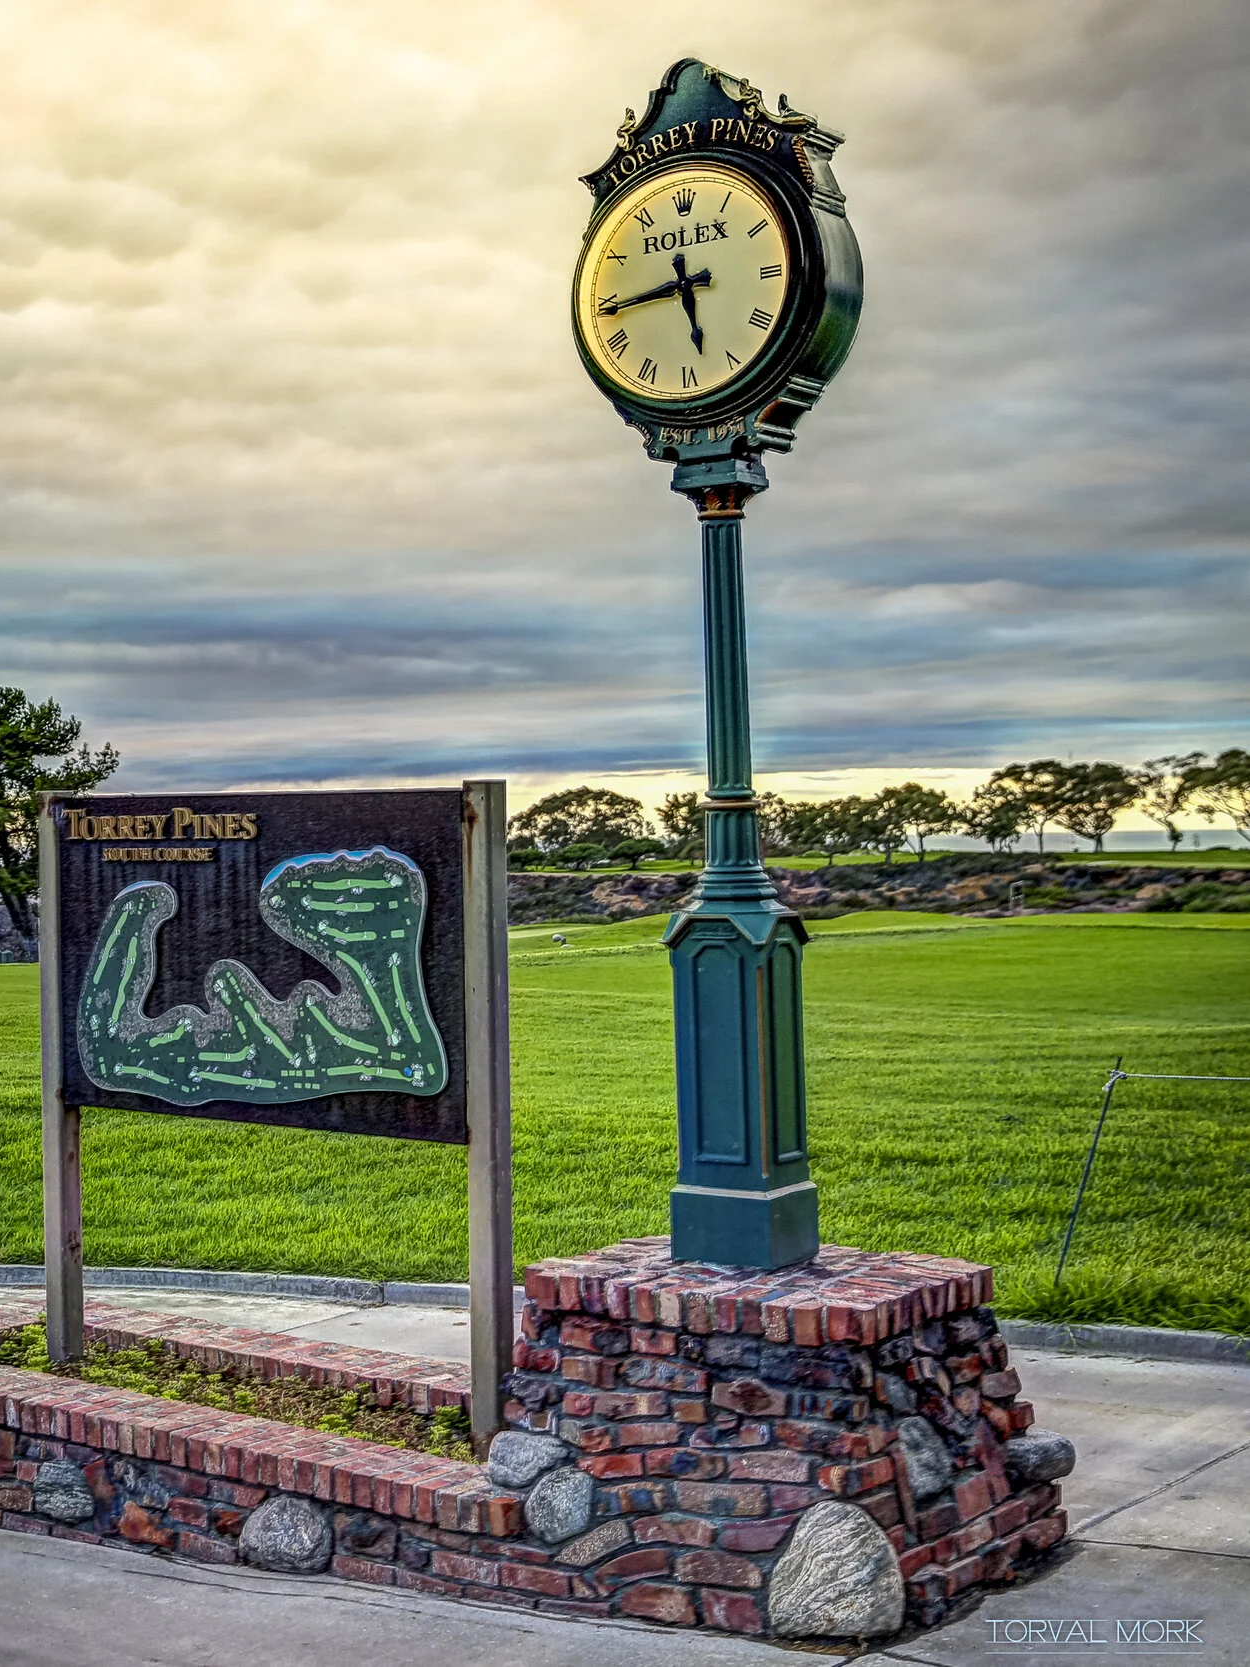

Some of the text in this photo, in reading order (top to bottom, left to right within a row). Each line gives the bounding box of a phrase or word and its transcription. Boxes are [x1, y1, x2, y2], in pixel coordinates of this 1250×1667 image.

[603, 118, 779, 186] TORREY PINES
[643, 220, 729, 255] ROLEX
[61, 807, 258, 840] TORREY PINES
[102, 848, 214, 861] SOUTH COURSE
